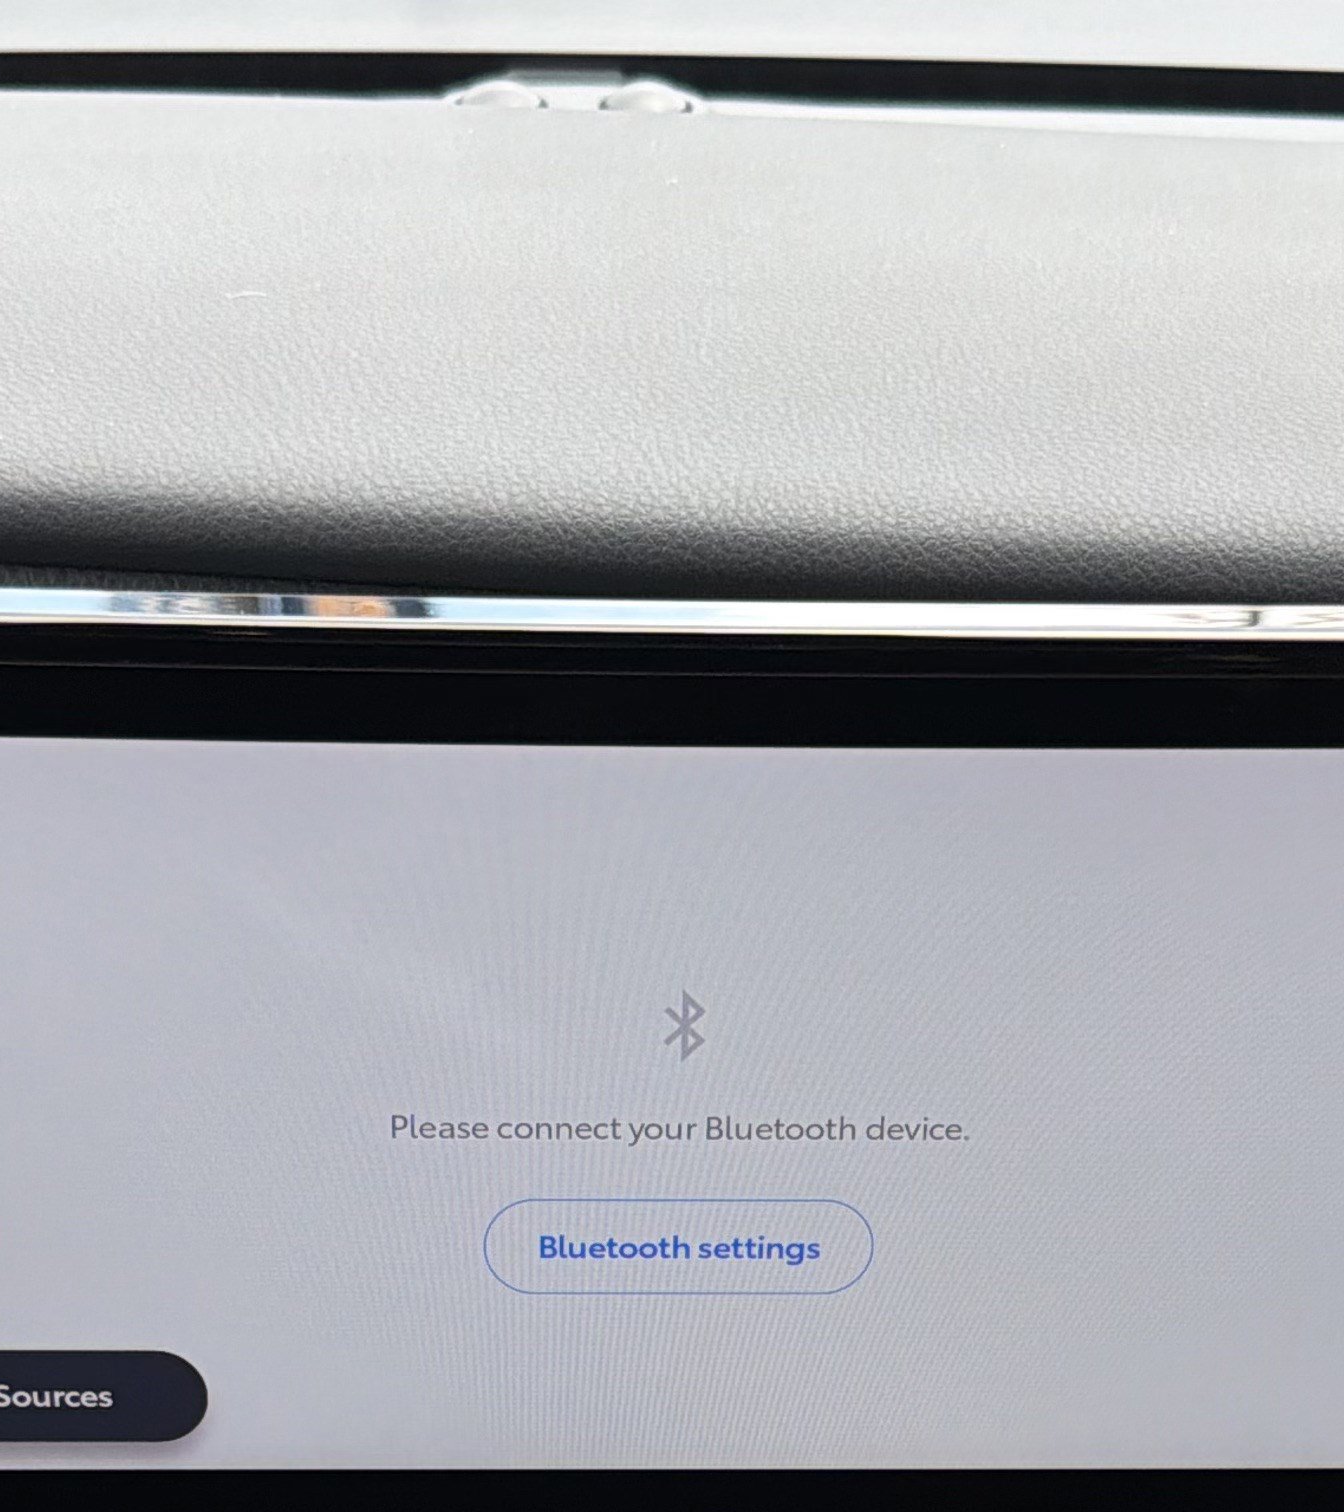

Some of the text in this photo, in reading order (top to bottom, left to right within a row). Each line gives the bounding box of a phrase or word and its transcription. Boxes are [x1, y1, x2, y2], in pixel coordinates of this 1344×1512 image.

[391, 1113, 970, 1147] Please connect your Bluetooth device.
[539, 1234, 821, 1266] Bluetooth settings
